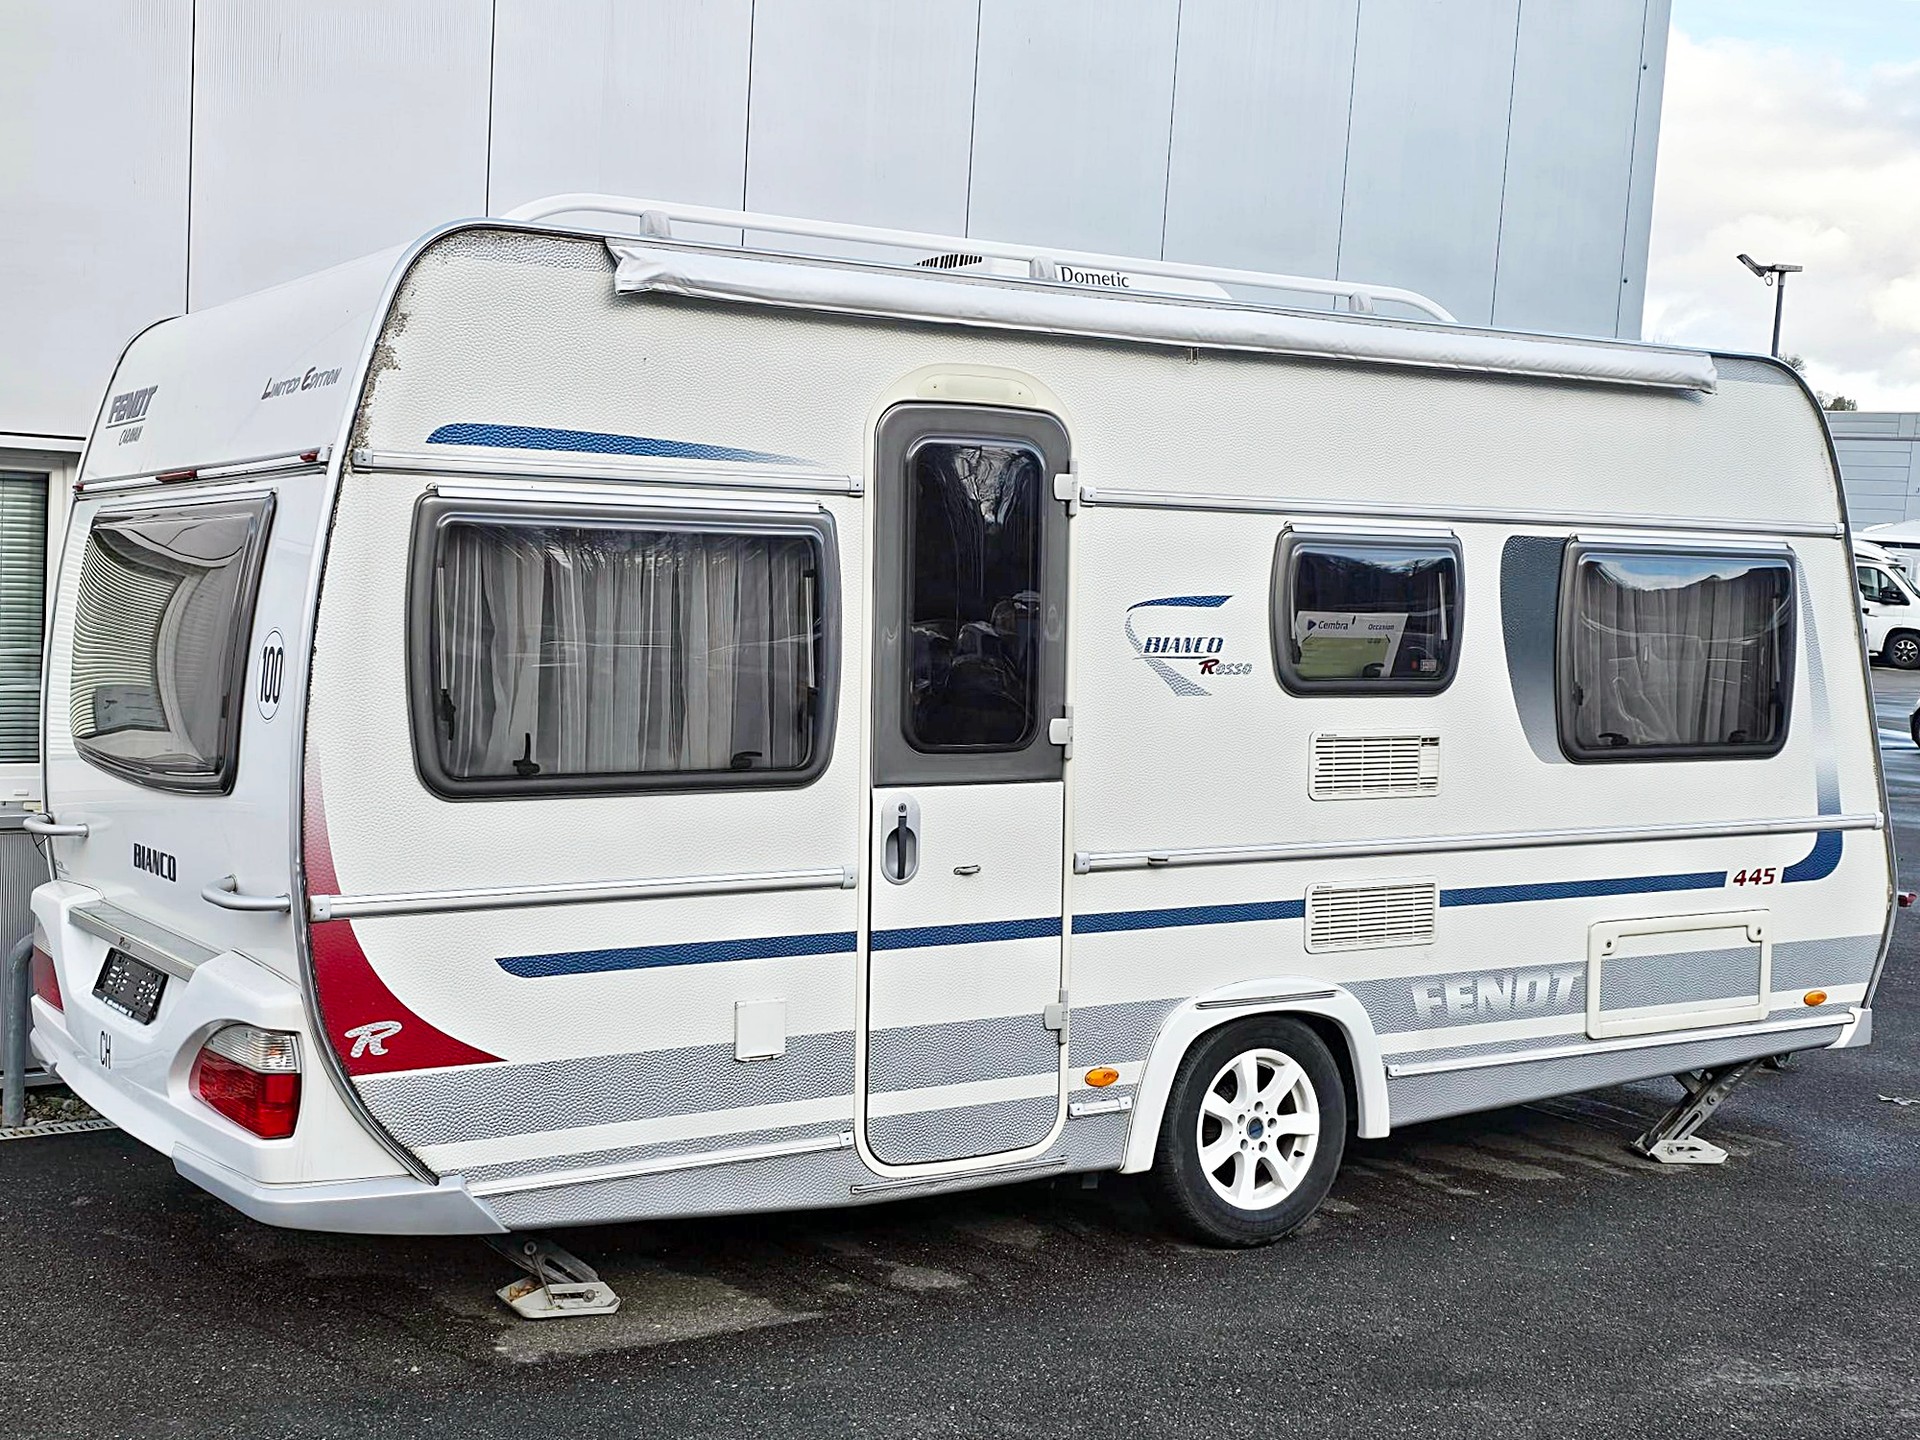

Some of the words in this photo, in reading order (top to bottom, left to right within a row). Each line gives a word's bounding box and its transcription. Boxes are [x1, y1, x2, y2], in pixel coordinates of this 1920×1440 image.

[1060, 266, 1129, 288] Dometic
[107, 385, 158, 424] FENDT
[1318, 620, 1349, 630] Cembra
[1143, 637, 1224, 654] BIANCO
[260, 646, 284, 704] 100
[133, 842, 177, 882] BIANCO
[1732, 867, 1777, 886] 445
[1411, 969, 1584, 1019] FENDT
[100, 1030, 111, 1070] CH
